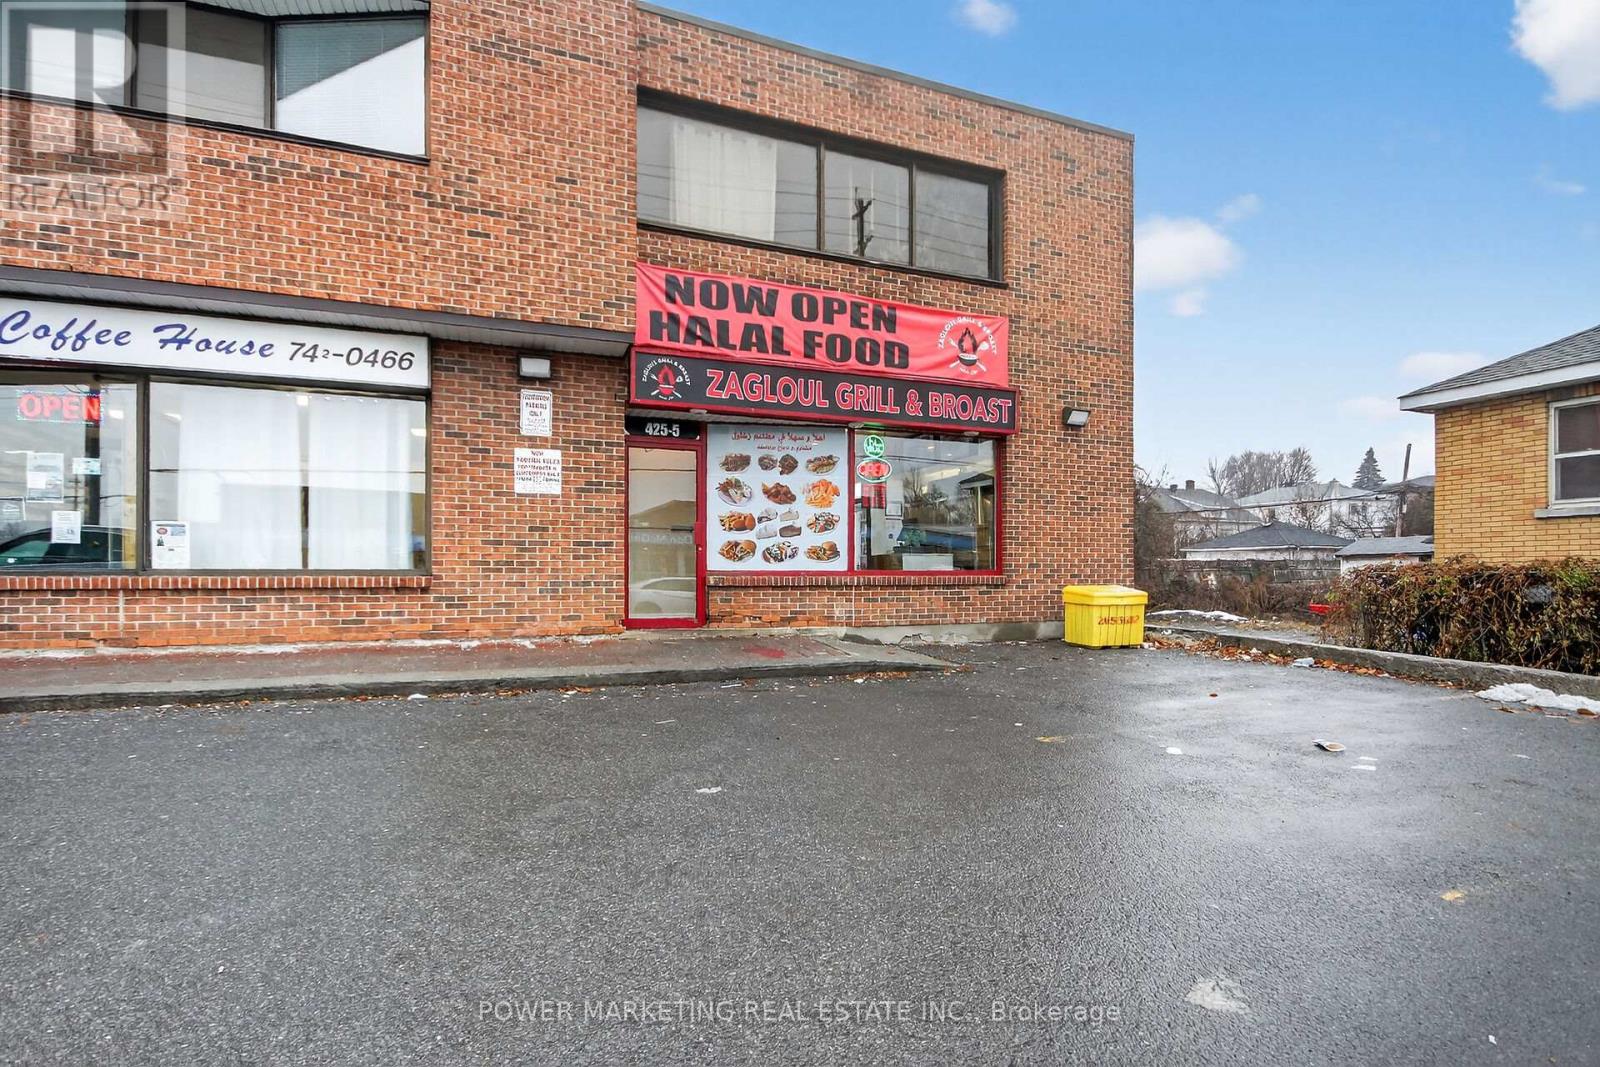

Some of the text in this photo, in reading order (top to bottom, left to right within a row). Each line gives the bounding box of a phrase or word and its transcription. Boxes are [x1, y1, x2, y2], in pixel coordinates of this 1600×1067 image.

[665, 273, 897, 334] NOW OPEN
[0, 310, 415, 371] Coffee House 742-0466
[649, 310, 909, 370] HALAL FOOD
[19, 392, 101, 421] OPEN
[706, 369, 1012, 423] ZAGLOUL GRILL & BROAST
[645, 422, 680, 437] 425-5
